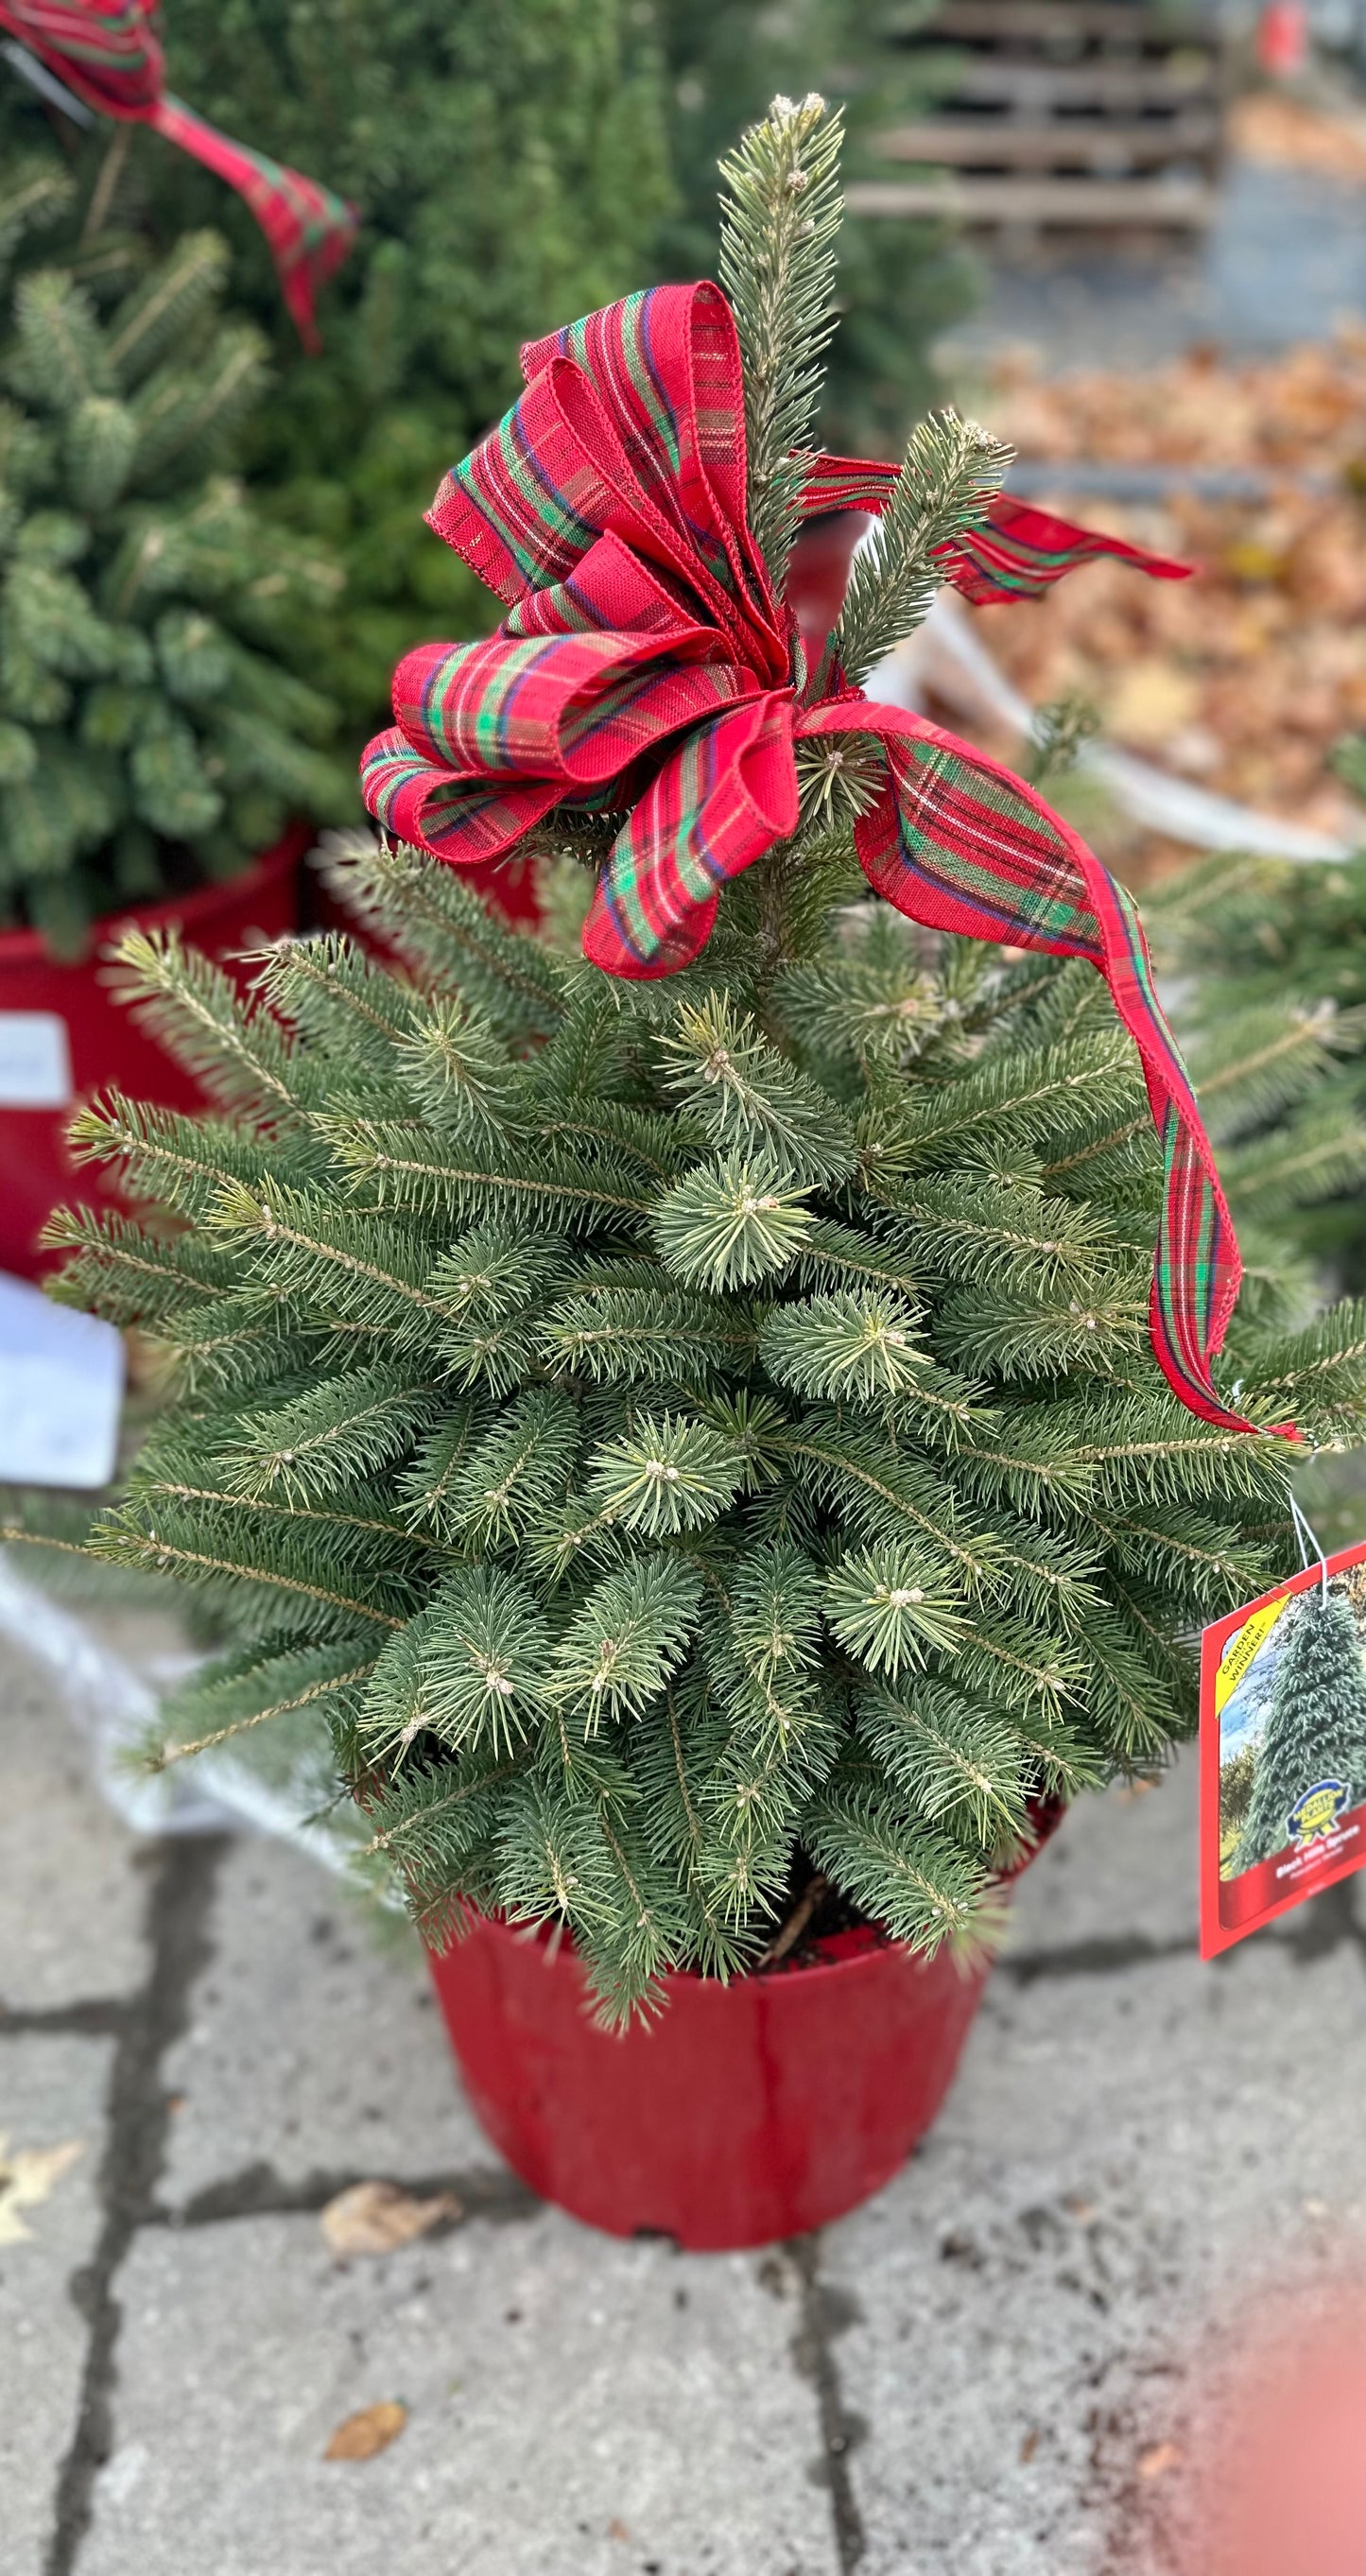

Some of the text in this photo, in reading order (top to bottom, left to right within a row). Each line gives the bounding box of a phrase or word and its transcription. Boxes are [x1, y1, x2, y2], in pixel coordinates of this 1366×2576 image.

[1221, 1623, 1254, 1675] GARDEN
[1229, 1628, 1265, 1682] WINNER!
[1293, 1788, 1343, 1823] MEDALLION
[1276, 1857, 1303, 1879] Black
[1325, 1824, 1360, 1849] Spruce
